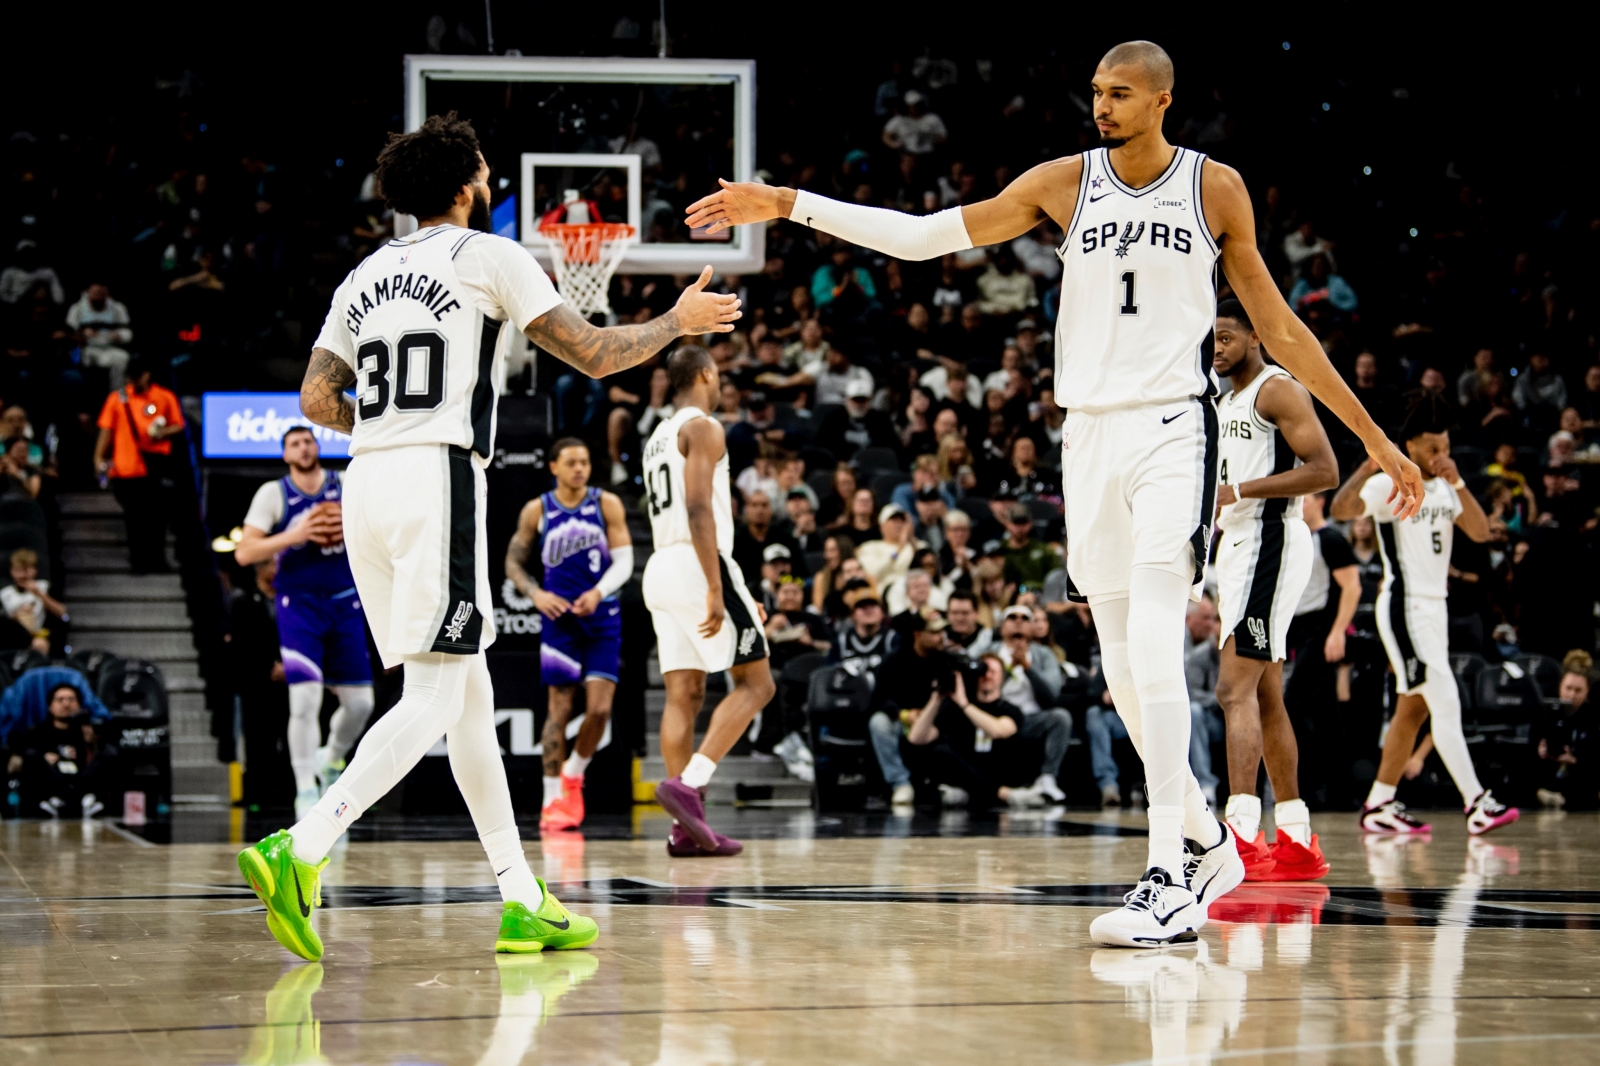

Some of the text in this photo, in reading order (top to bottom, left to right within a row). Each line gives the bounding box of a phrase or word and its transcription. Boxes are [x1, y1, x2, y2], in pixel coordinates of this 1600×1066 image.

[1082, 221, 1192, 259] SPURS
[346, 272, 461, 336] CHAMPAGNIE
[1119, 270, 1140, 316] 1
[355, 328, 449, 425] 30
[648, 462, 672, 517] 40
[587, 548, 601, 573] 3
[1431, 530, 1442, 555] 5
